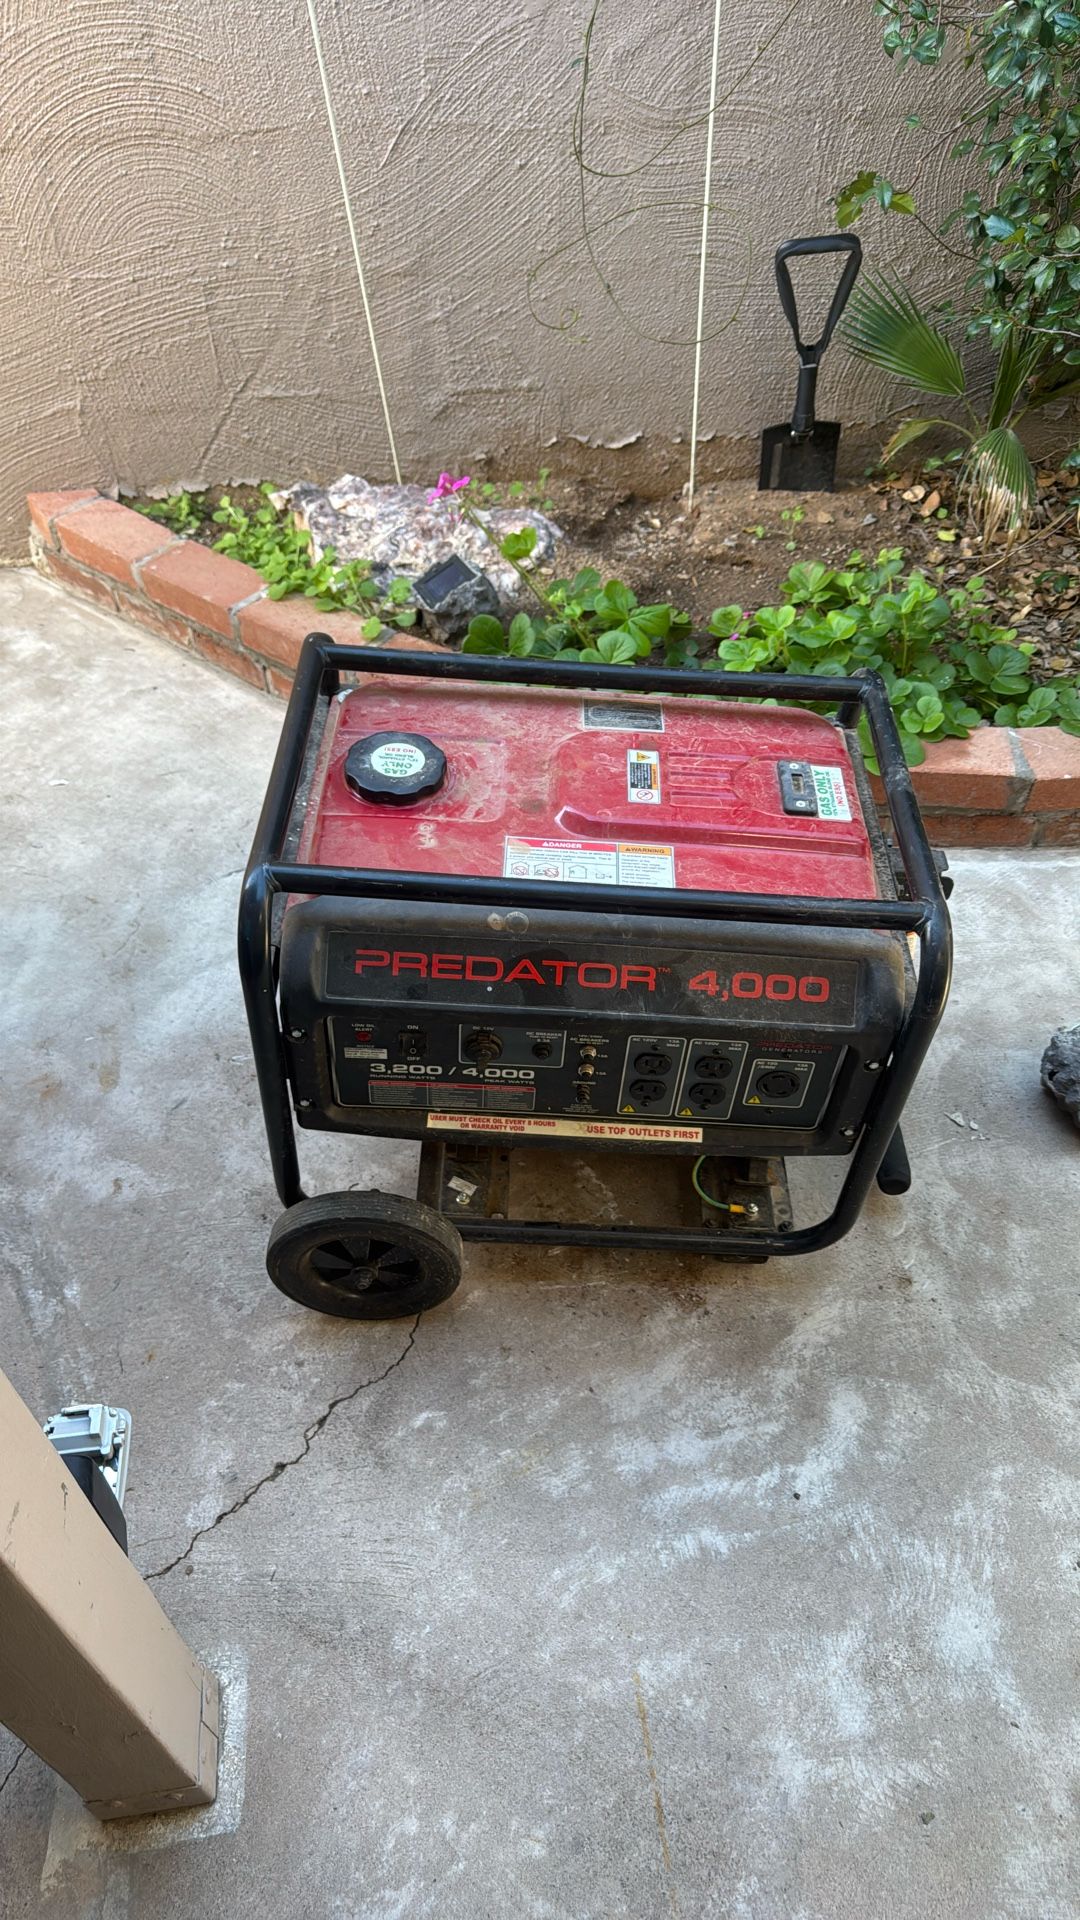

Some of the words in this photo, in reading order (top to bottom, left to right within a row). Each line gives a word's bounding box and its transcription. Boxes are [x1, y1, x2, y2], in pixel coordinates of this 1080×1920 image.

[382, 761, 413, 769] ONLY
[814, 770, 828, 795] ONLY
[819, 797, 833, 816] GAS
[354, 949, 657, 992] PREDATOR
[688, 970, 830, 1003] 4,000
[370, 1063, 443, 1075] 3,200
[448, 1066, 457, 1076] /
[462, 1067, 535, 1079] 4,000
[471, 1123, 508, 1131] WARRANTY
[505, 1118, 526, 1126] EVERY
[587, 1126, 606, 1134] USE
[608, 1127, 626, 1135] TOP
[629, 1128, 671, 1138] OUTLETS
[673, 1130, 700, 1139] FIRST
